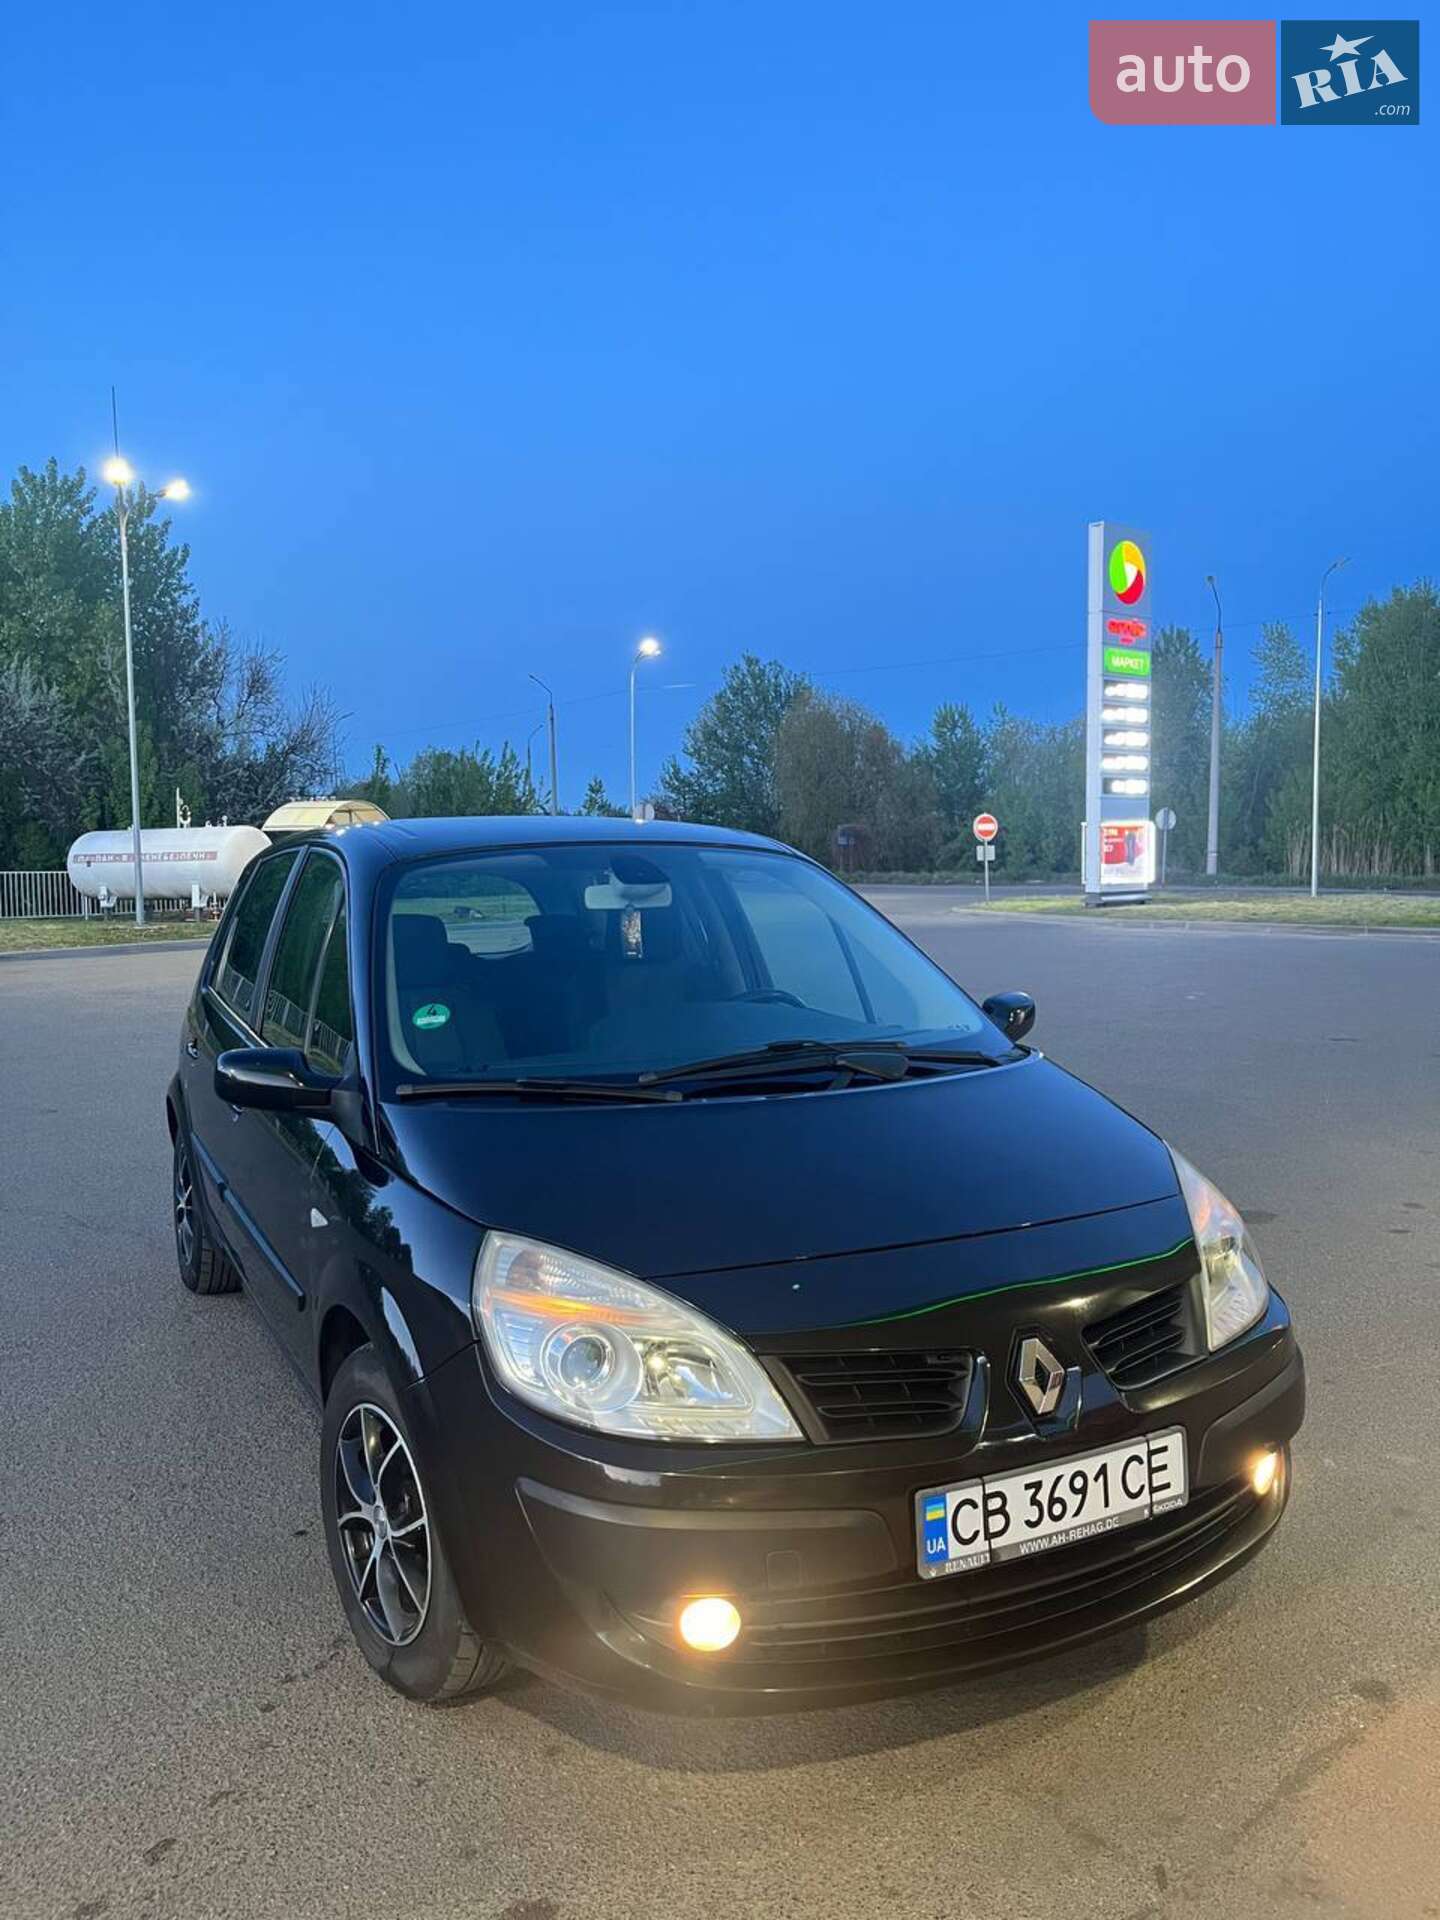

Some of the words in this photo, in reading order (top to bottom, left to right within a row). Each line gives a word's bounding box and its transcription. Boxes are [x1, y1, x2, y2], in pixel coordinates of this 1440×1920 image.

[951, 1492, 1011, 1546] CB
[1023, 1463, 1110, 1530] 3691
[1121, 1445, 1171, 1500] CE
[926, 1537, 946, 1555] UA
[1019, 1517, 1120, 1554] WWW.AH-REHAG.DE
